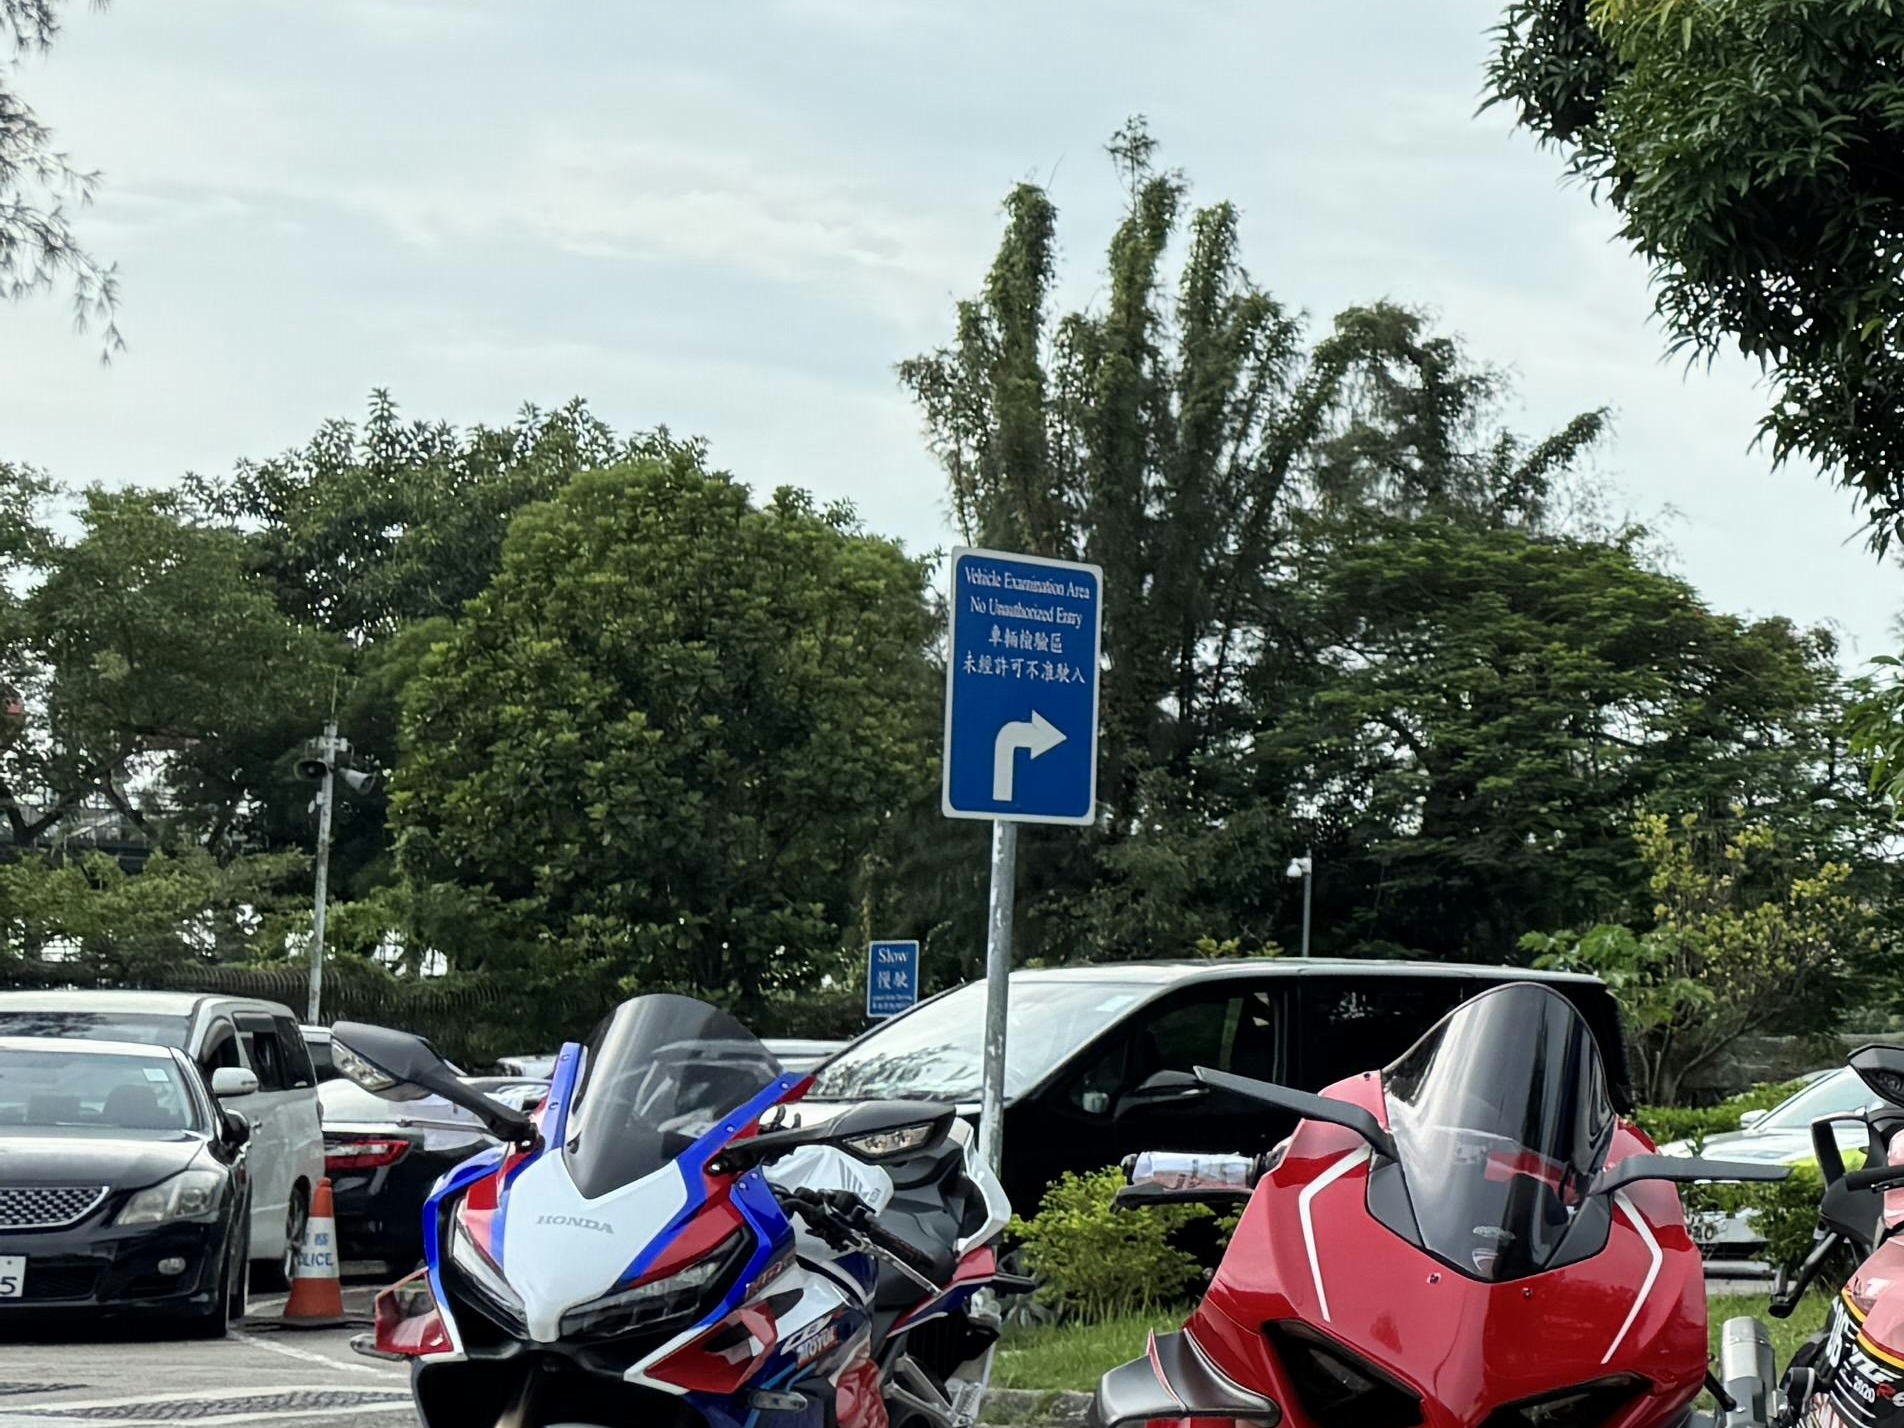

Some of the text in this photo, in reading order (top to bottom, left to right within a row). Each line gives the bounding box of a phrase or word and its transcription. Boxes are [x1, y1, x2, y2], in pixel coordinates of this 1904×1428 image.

[965, 566, 1090, 599] Vehicle Examination Area
[970, 595, 986, 614] No
[1056, 606, 1082, 629] Entry
[536, 1215, 615, 1234] HONDA
[298, 1252, 334, 1267] LICE
